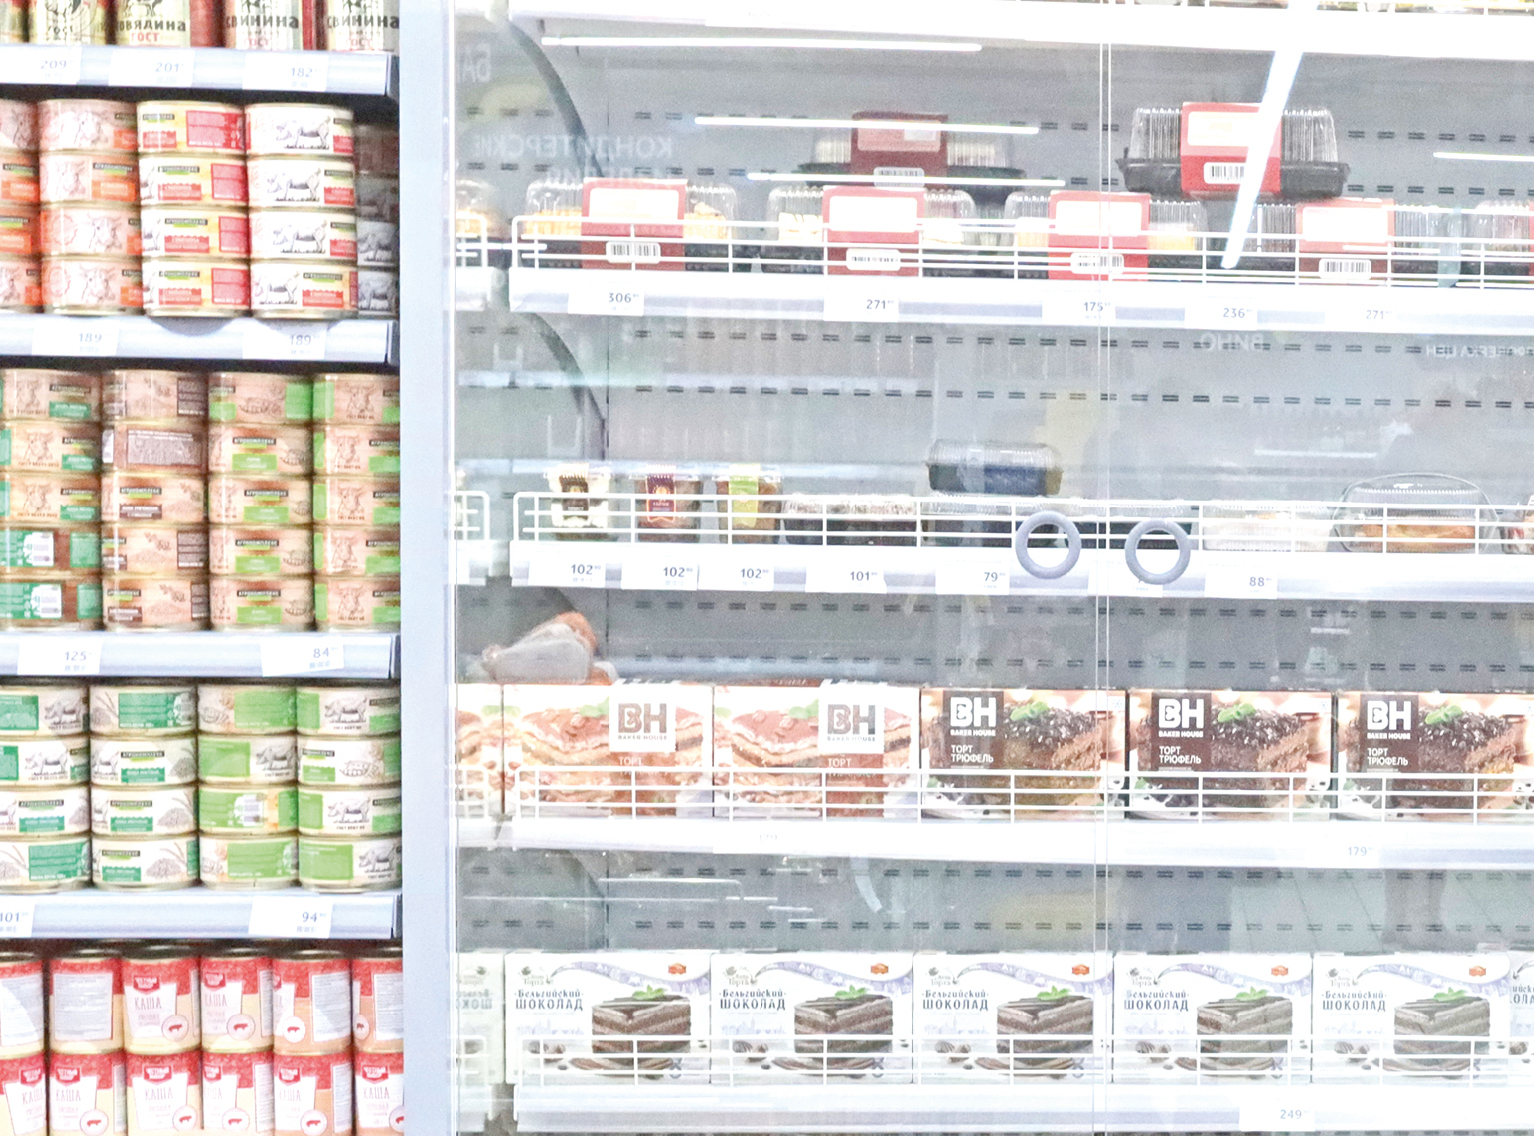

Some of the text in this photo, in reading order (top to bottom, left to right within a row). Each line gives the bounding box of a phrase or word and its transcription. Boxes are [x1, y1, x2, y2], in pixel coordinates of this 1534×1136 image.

[117, 19, 187, 33] ОВЯДИНА
[131, 32, 160, 43] ГОСТ
[290, 67, 312, 78] 182
[608, 292, 632, 304] 306
[866, 299, 886, 310] 271
[1222, 307, 1245, 319] 236
[570, 564, 593, 575] 102
[662, 566, 686, 578] 102
[739, 568, 762, 579] 102
[849, 571, 870, 581] 101
[983, 572, 999, 582] 79
[1248, 576, 1265, 587] 88
[64, 650, 88, 662] 125
[312, 647, 330, 659] 84
[618, 702, 668, 734] BH
[950, 696, 997, 728] BH
[1158, 698, 1205, 730] BH
[1366, 700, 1412, 731] BH
[827, 704, 876, 735] BH
[950, 745, 973, 754] ТОРТ
[1159, 745, 1182, 755] ТОРТ
[1367, 747, 1390, 757] ТОРТ
[618, 756, 643, 766] ТОРТ
[827, 757, 852, 768] ТОРТ
[950, 753, 994, 764] ТРЮФЕЛЬ
[1158, 754, 1202, 765] ТРЮФЕЛЬ
[1366, 756, 1409, 767] ТРЮФЕЛЬ
[1347, 845, 1368, 857] 179
[301, 912, 318, 923] 94
[134, 996, 162, 1010] КАША
[515, 998, 584, 1012] ШОКОЛАД
[720, 998, 786, 1012] ШОКОЛАД
[921, 998, 989, 1012] ШОКОЛАД
[1123, 999, 1189, 1012] ШОКОЛАД
[1321, 999, 1386, 1012] ШОКОЛАД
[144, 1087, 173, 1100] КАША
[363, 1087, 390, 1100] КАША
[1279, 1109, 1303, 1120] 249
